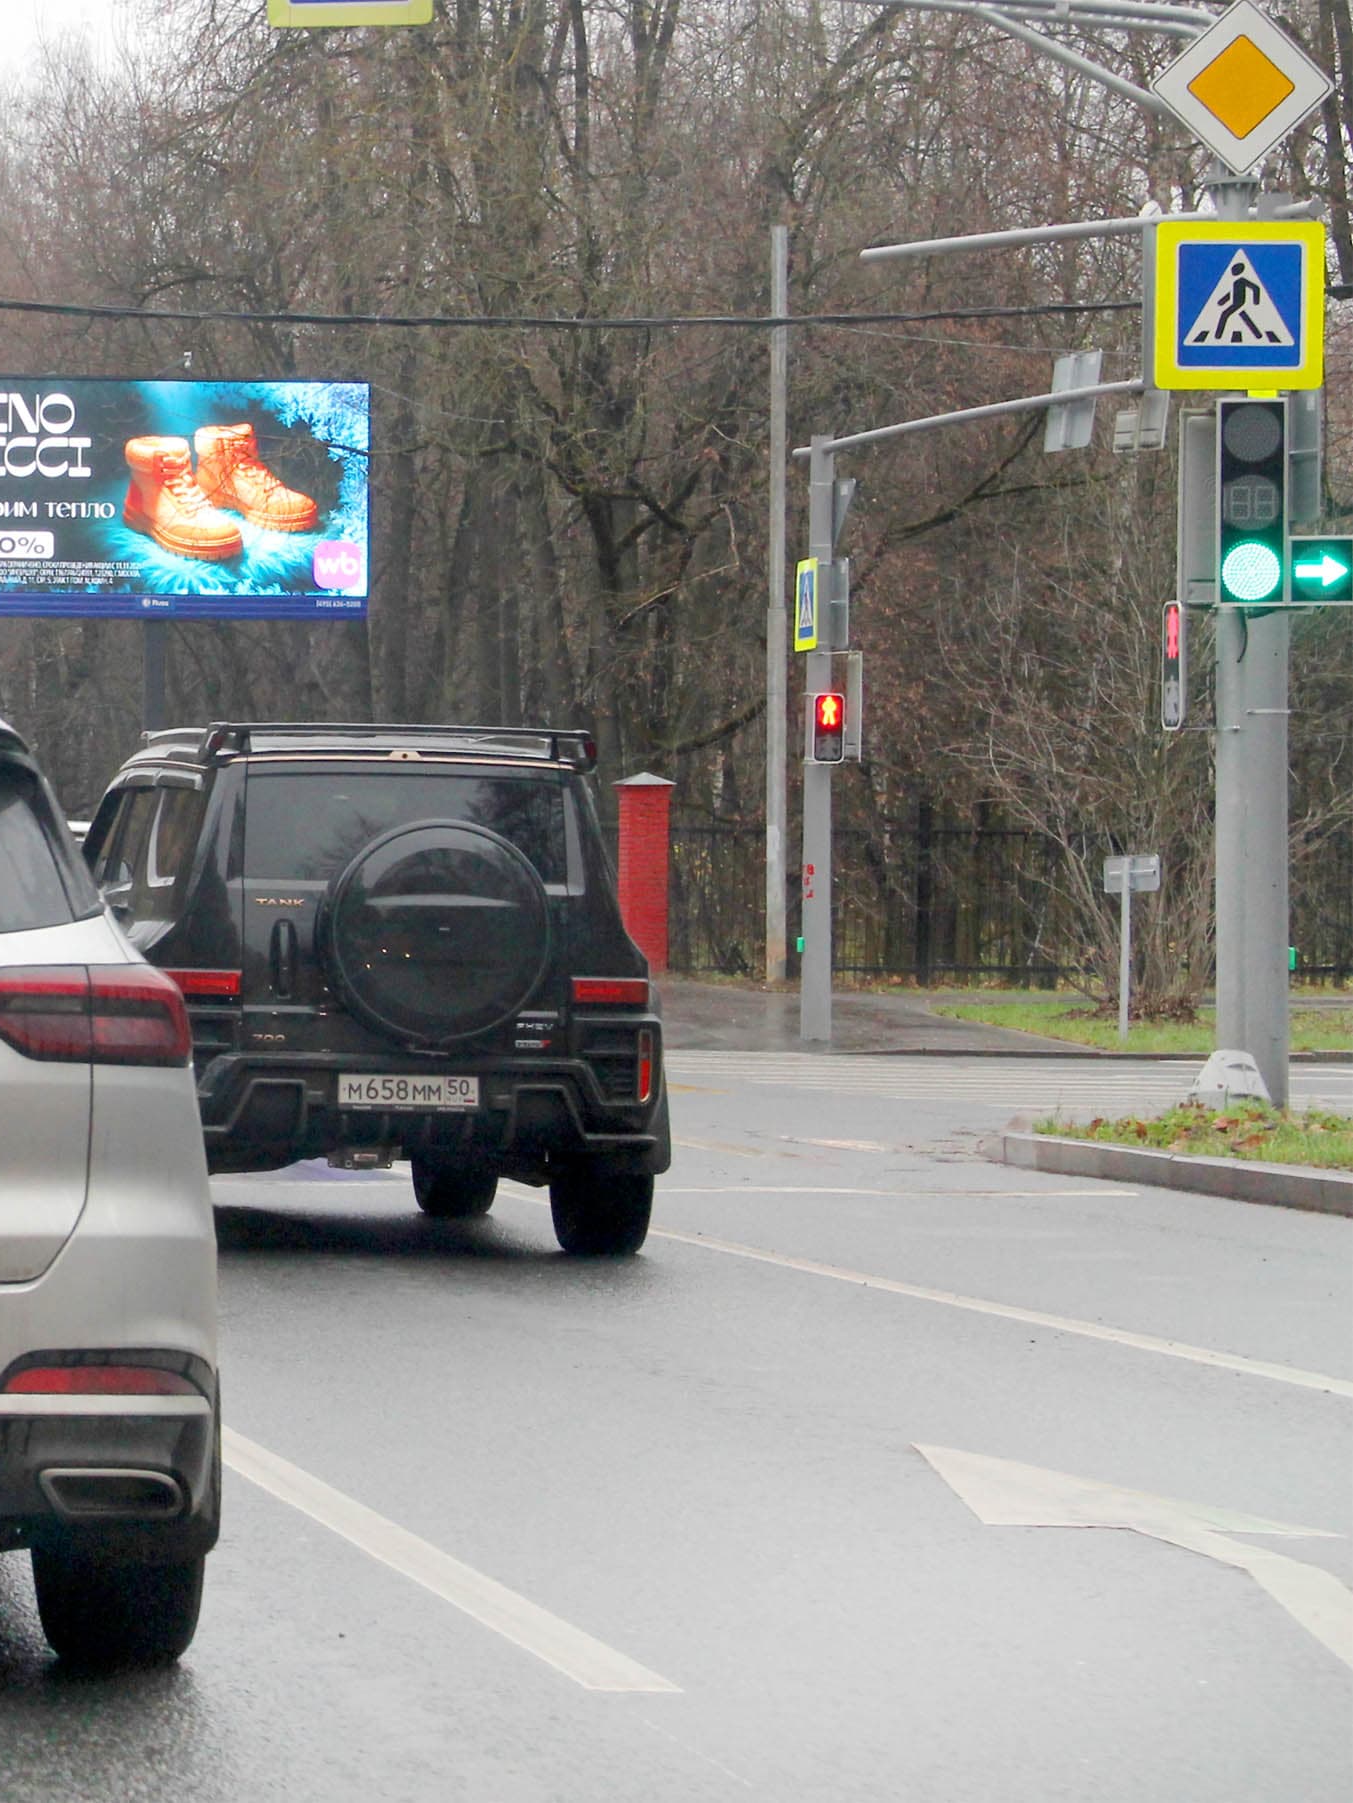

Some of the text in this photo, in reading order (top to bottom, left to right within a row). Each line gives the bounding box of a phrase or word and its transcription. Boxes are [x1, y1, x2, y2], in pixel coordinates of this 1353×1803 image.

[44, 500, 116, 519] тепло
[318, 551, 358, 575] wb
[255, 898, 304, 906] TANK
[447, 1079, 469, 1096] 50
